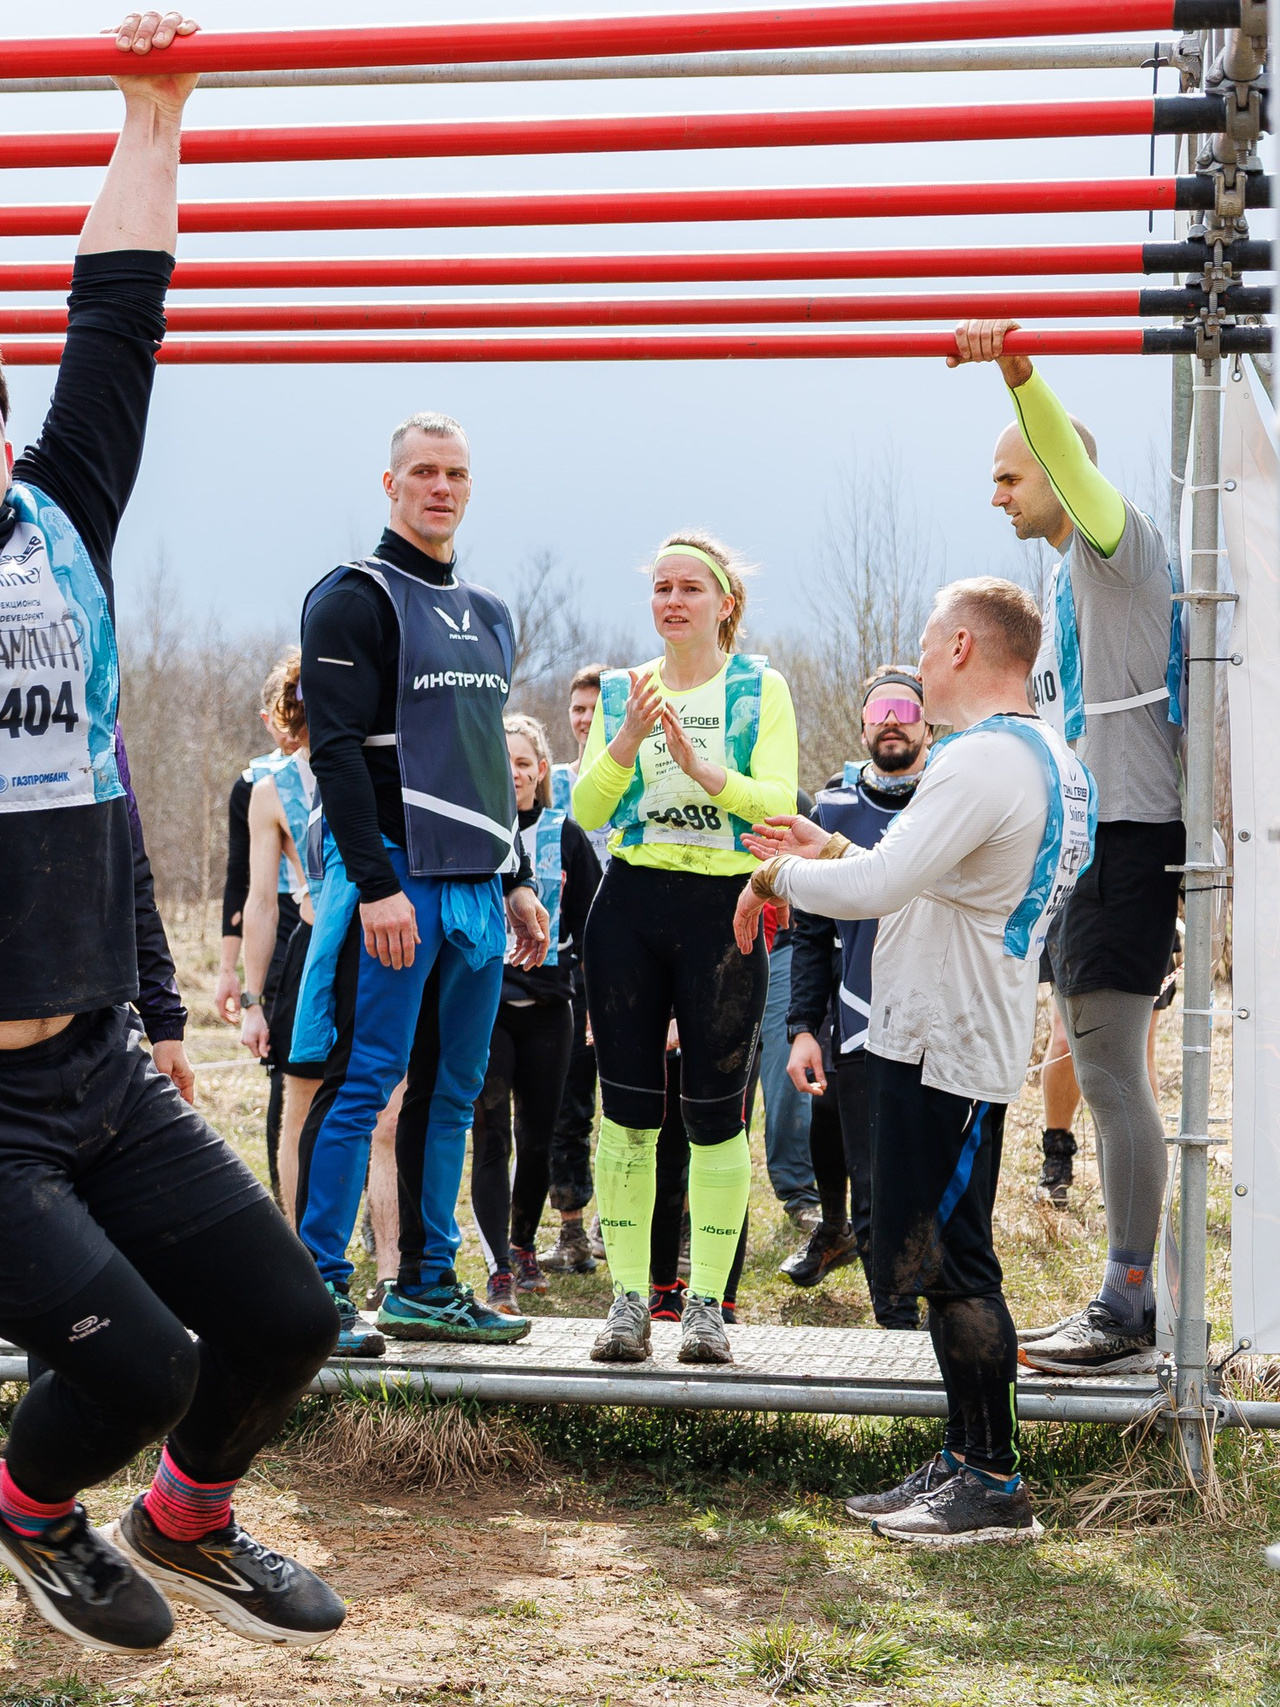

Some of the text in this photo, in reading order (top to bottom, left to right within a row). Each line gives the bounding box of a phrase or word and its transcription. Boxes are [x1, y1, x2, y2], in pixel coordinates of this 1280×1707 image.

[413, 670, 509, 694] ИНСТРУКТО
[1034, 669, 1057, 708] 410
[11, 771, 71, 788] ГАЗПРОМБАНК
[699, 1224, 738, 1236] JÖGEL
